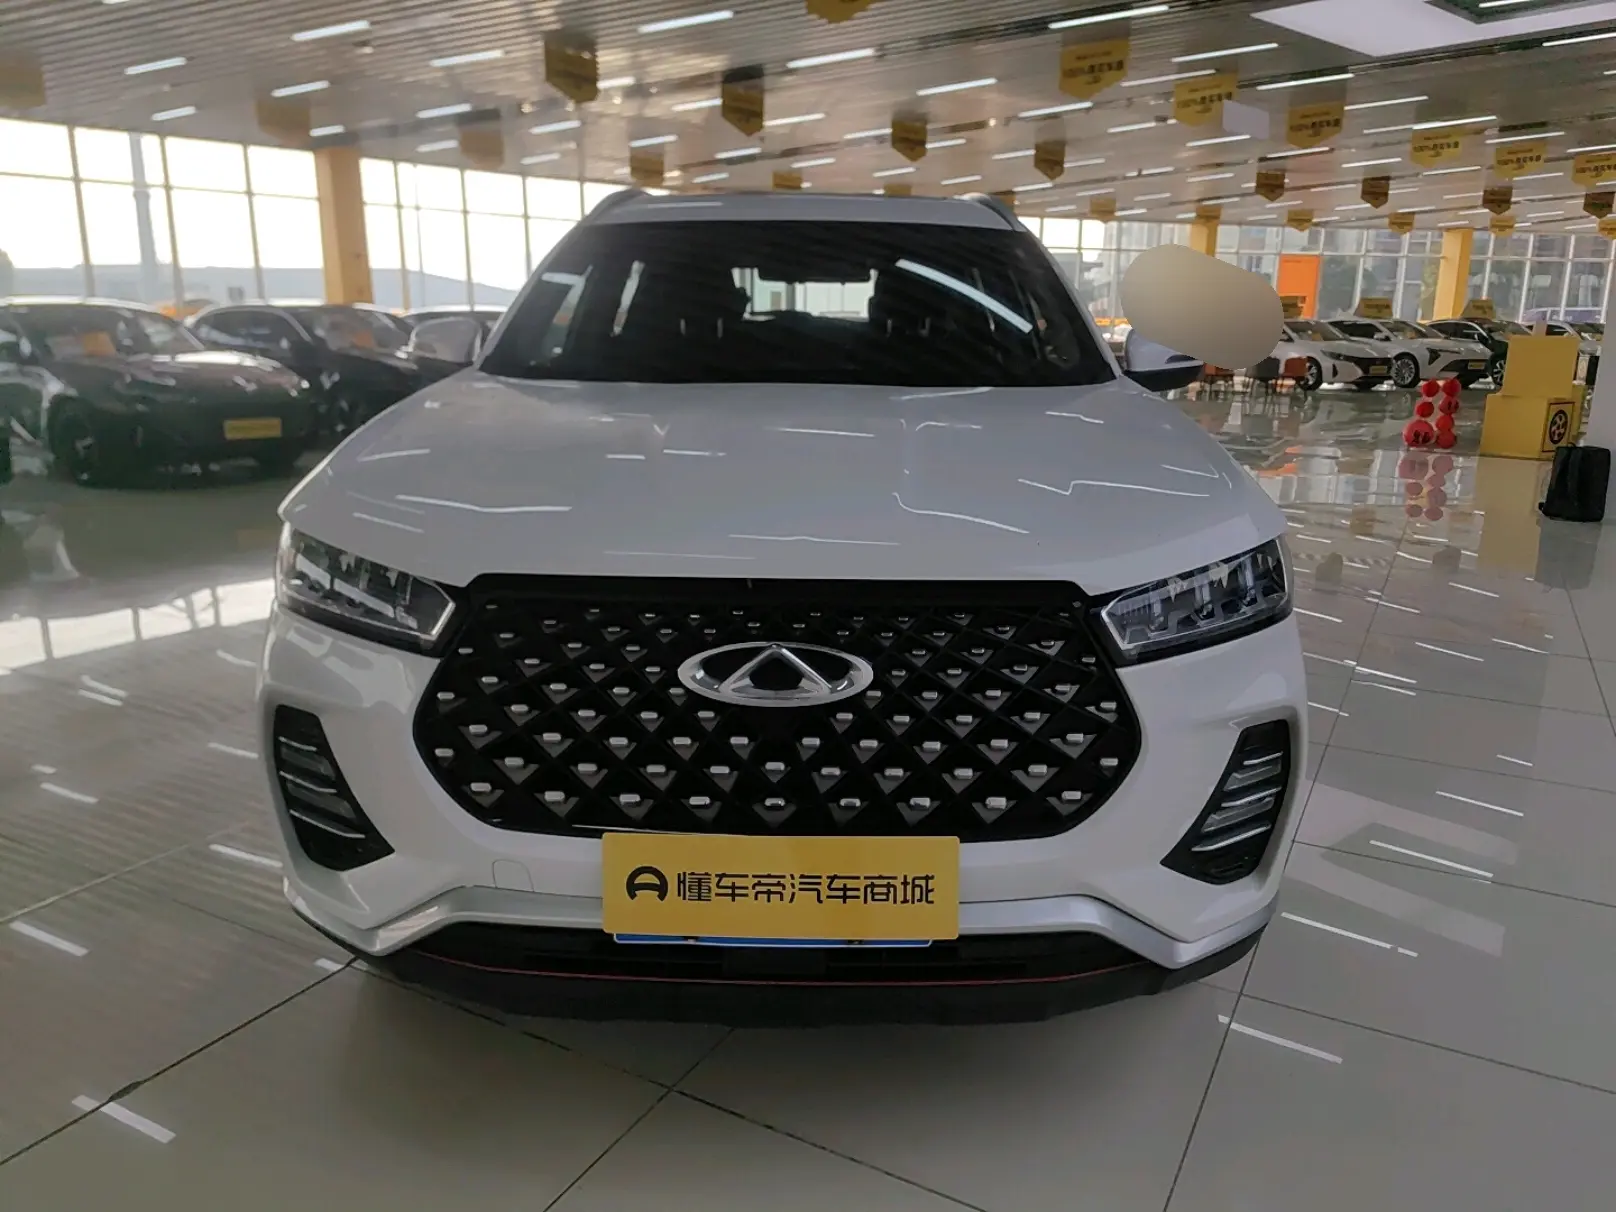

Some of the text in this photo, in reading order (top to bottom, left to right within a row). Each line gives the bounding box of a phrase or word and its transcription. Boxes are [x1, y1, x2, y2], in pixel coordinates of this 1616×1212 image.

[677, 871, 935, 905] 懂车帝汽车商城
